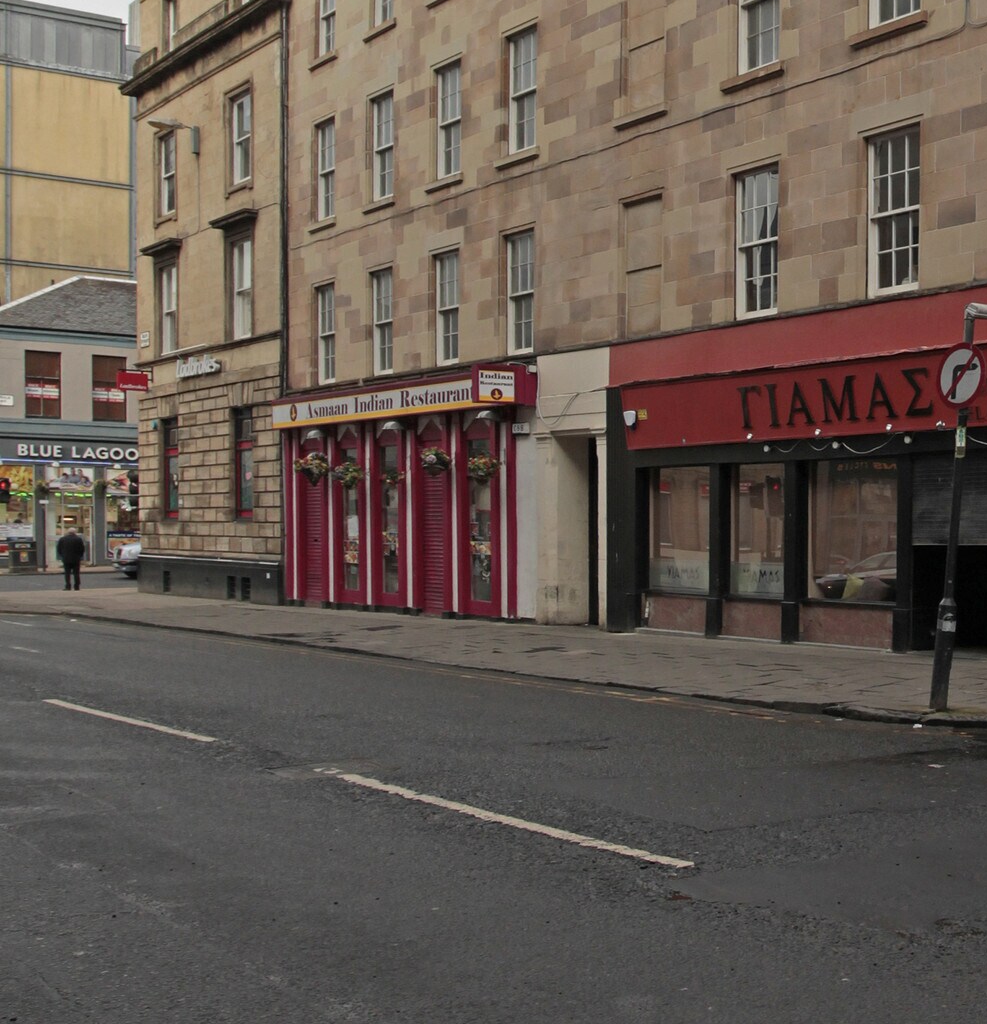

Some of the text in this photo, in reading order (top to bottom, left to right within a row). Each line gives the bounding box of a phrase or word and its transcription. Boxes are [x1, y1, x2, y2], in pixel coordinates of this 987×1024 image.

[176, 354, 221, 378] Ladbrokes
[480, 372, 513, 380] Indian
[306, 403, 348, 419] Asmaan
[354, 396, 394, 414] Indian
[17, 443, 63, 458] BLUE
